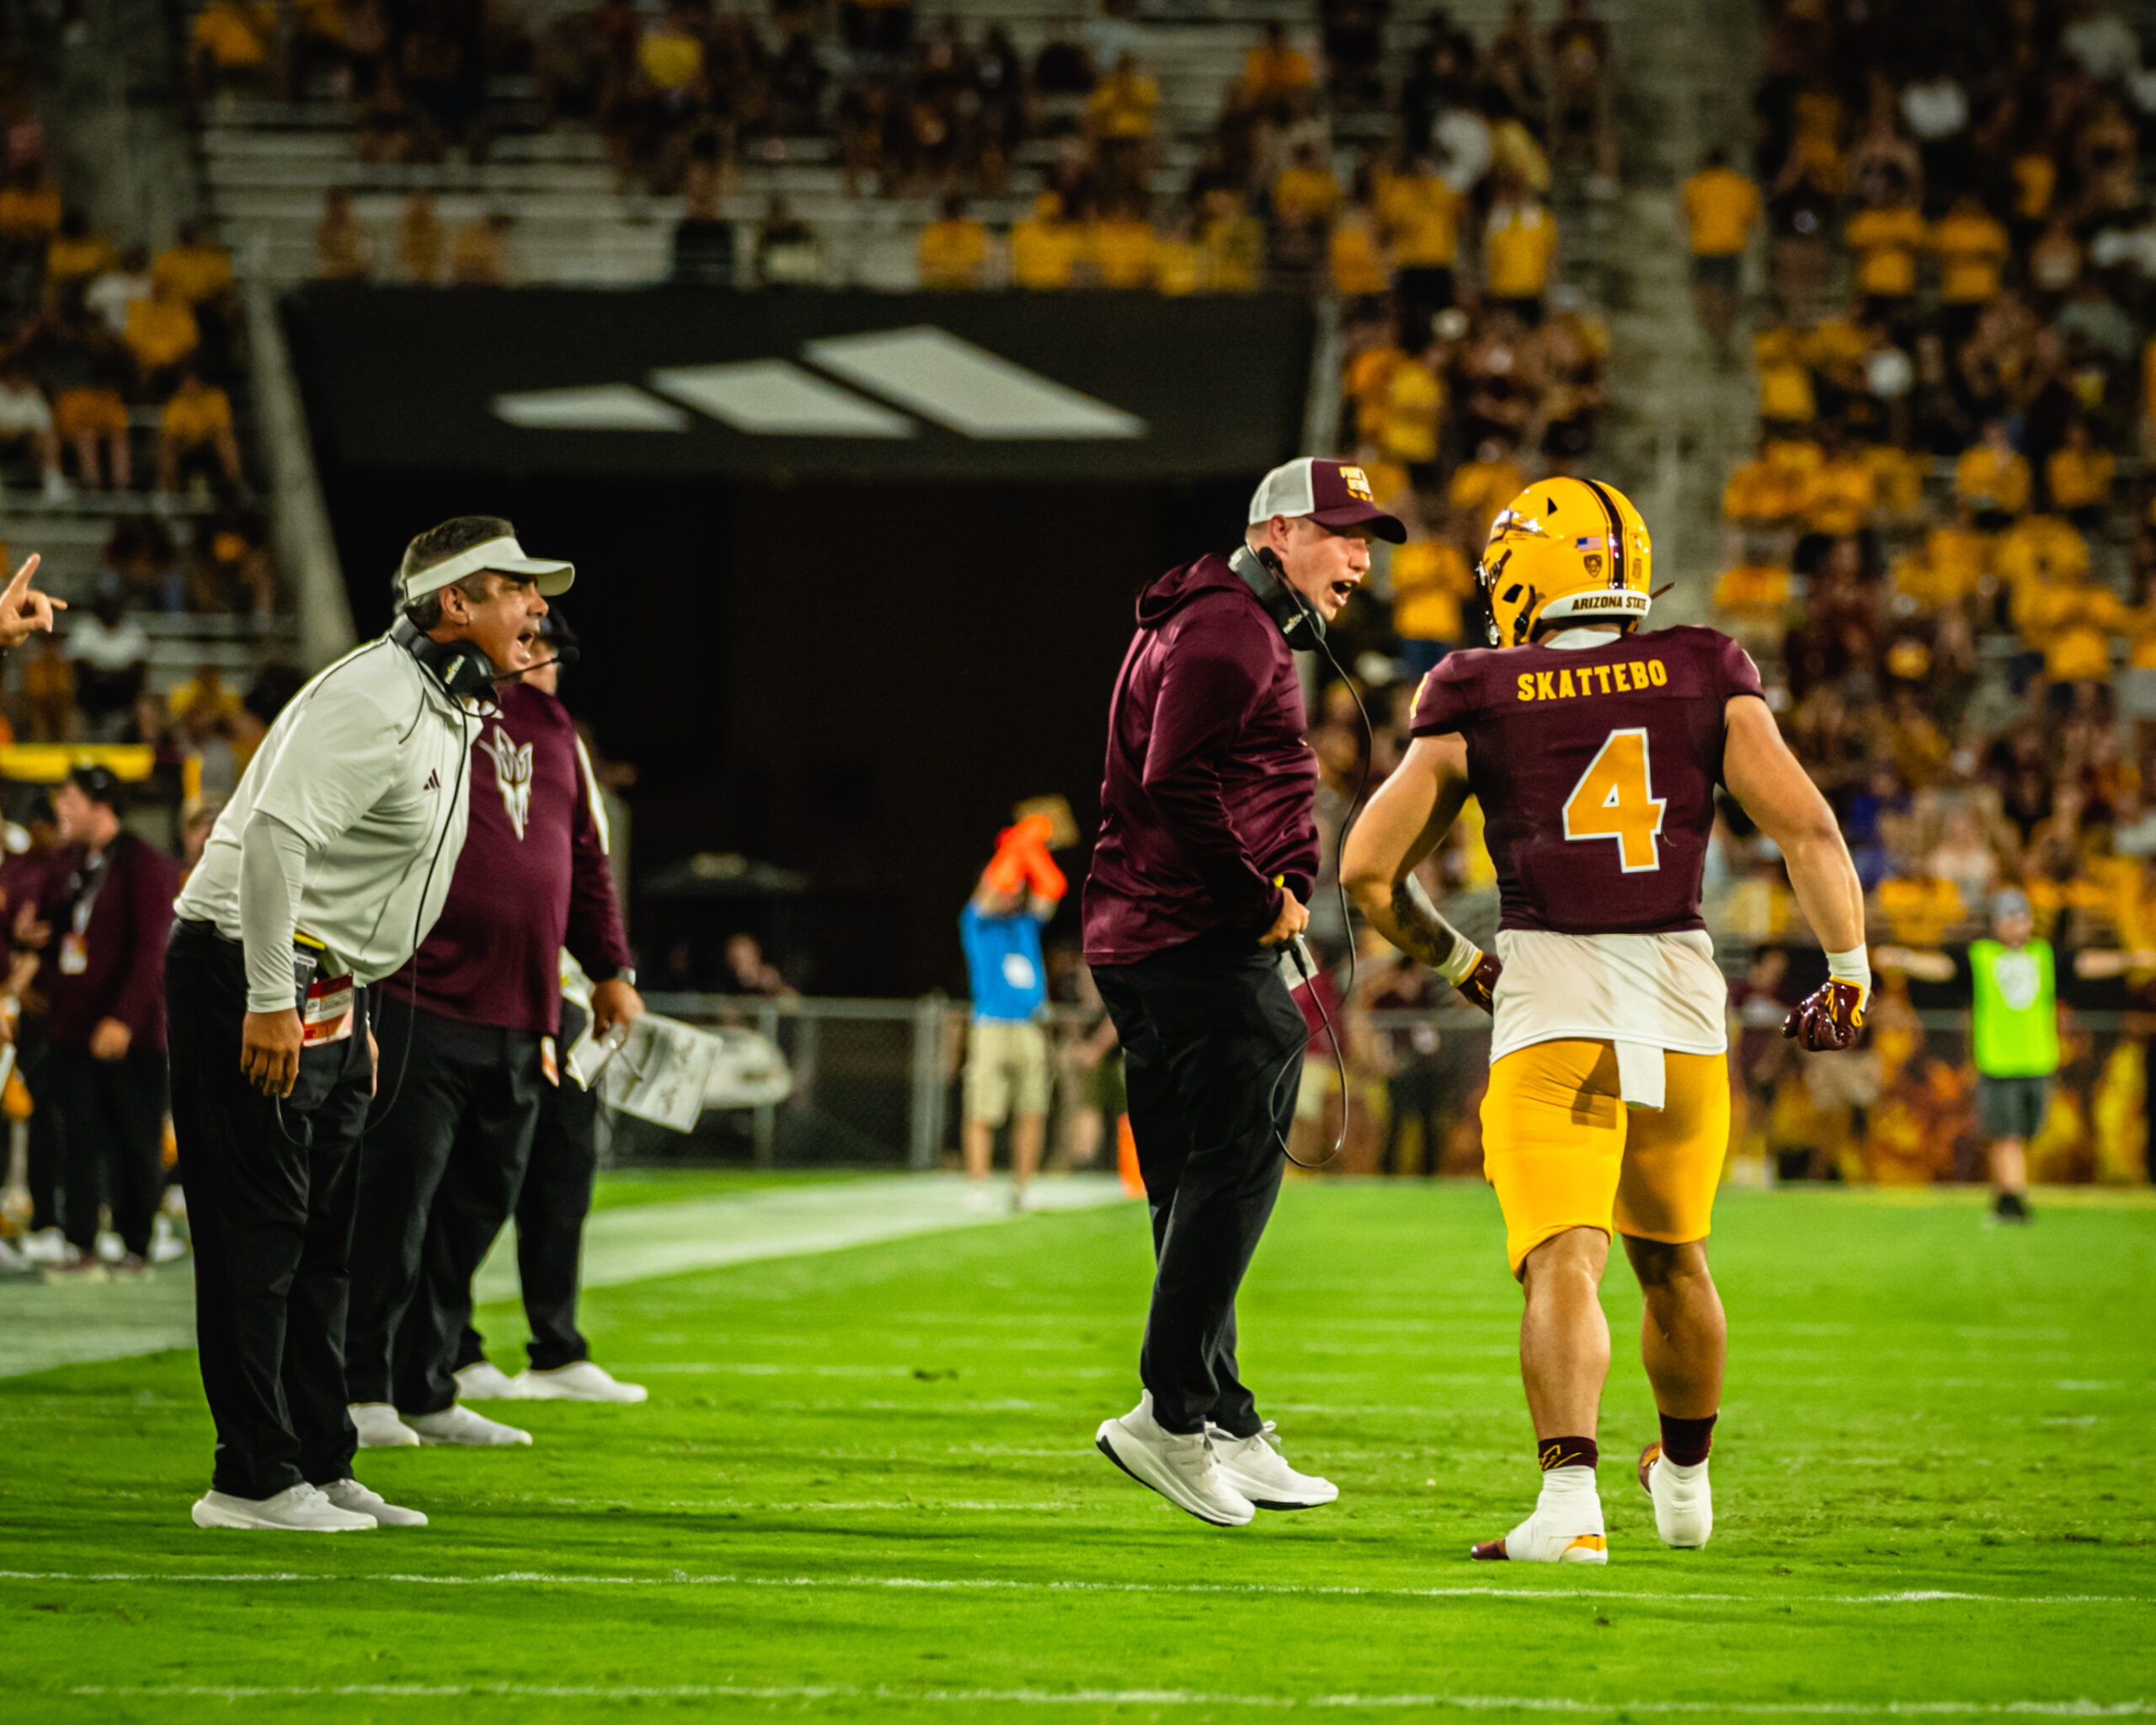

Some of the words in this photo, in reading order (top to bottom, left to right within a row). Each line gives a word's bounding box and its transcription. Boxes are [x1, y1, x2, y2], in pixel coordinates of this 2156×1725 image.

[1572, 595, 1623, 611] ARIZONA
[1625, 595, 1647, 611] STATE
[1517, 659, 1668, 702] SKATTEBO
[1562, 727, 1668, 873] 4
